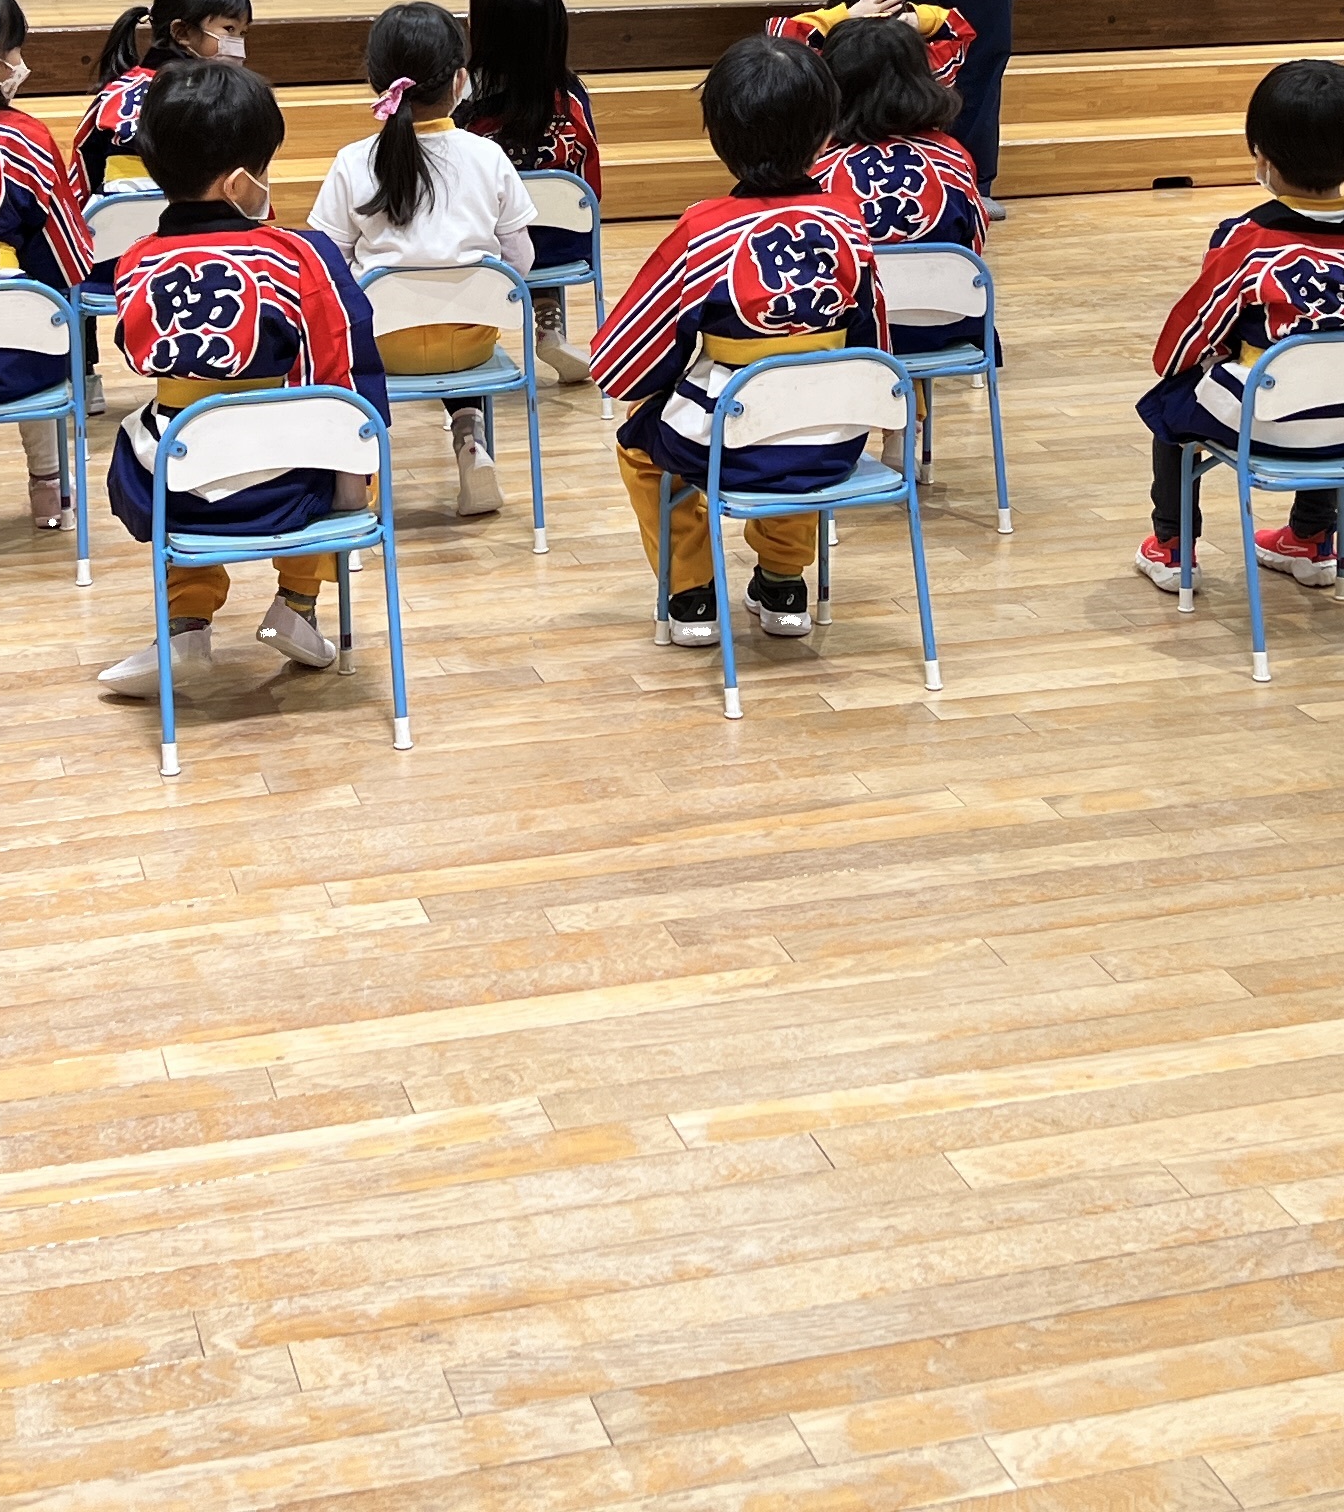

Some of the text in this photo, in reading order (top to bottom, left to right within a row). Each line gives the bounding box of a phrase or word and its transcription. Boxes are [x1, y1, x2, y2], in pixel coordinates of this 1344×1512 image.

[843, 142, 930, 243] 防火
[142, 259, 246, 381] 防火
[747, 219, 851, 329] 防火
